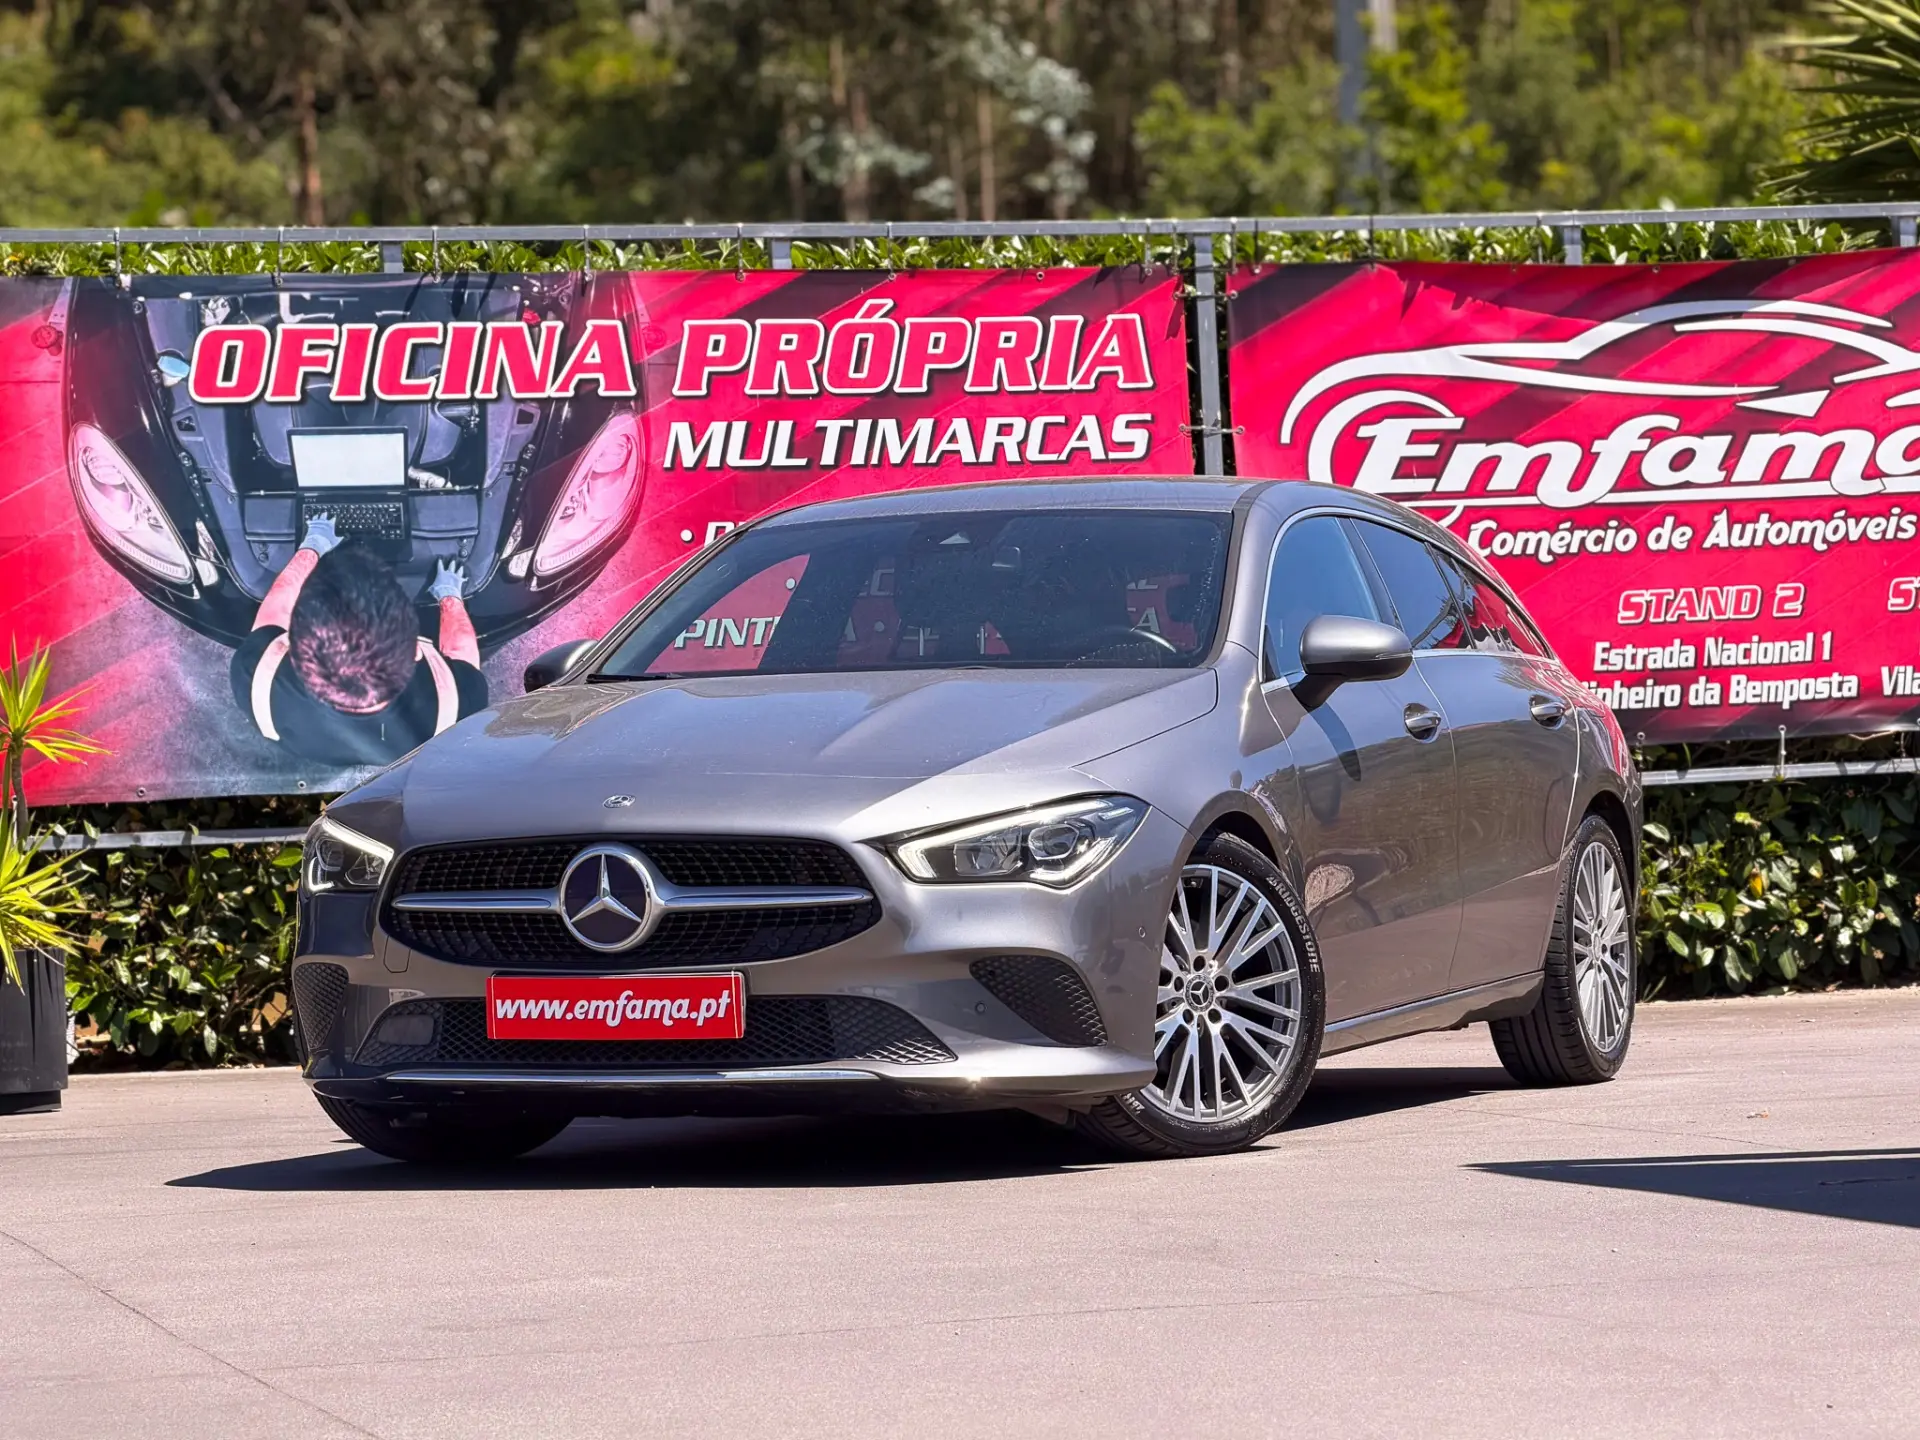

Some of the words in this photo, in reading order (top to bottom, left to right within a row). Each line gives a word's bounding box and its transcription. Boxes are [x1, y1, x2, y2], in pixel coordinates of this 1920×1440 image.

[187, 320, 637, 404] OFICINA
[673, 298, 1155, 397] PRÓPRIA
[663, 412, 1153, 469] MULTIMARCAS
[1468, 519, 1638, 564] Comércio
[1647, 515, 1692, 551] de
[1702, 507, 1917, 552] Automóveis
[1617, 584, 1762, 623] STAND
[1772, 582, 1804, 617] 2
[1887, 576, 1920, 611] S
[1593, 638, 1696, 672] Estrada
[1703, 632, 1814, 667] Nacional
[1821, 631, 1833, 660] 1
[1581, 679, 1681, 710] inheiro
[1689, 676, 1722, 706] da
[1729, 671, 1858, 709] Bemposta
[1265, 874, 1321, 973] BRIDGESTONE
[495, 989, 731, 1027] www.emfama.pt
